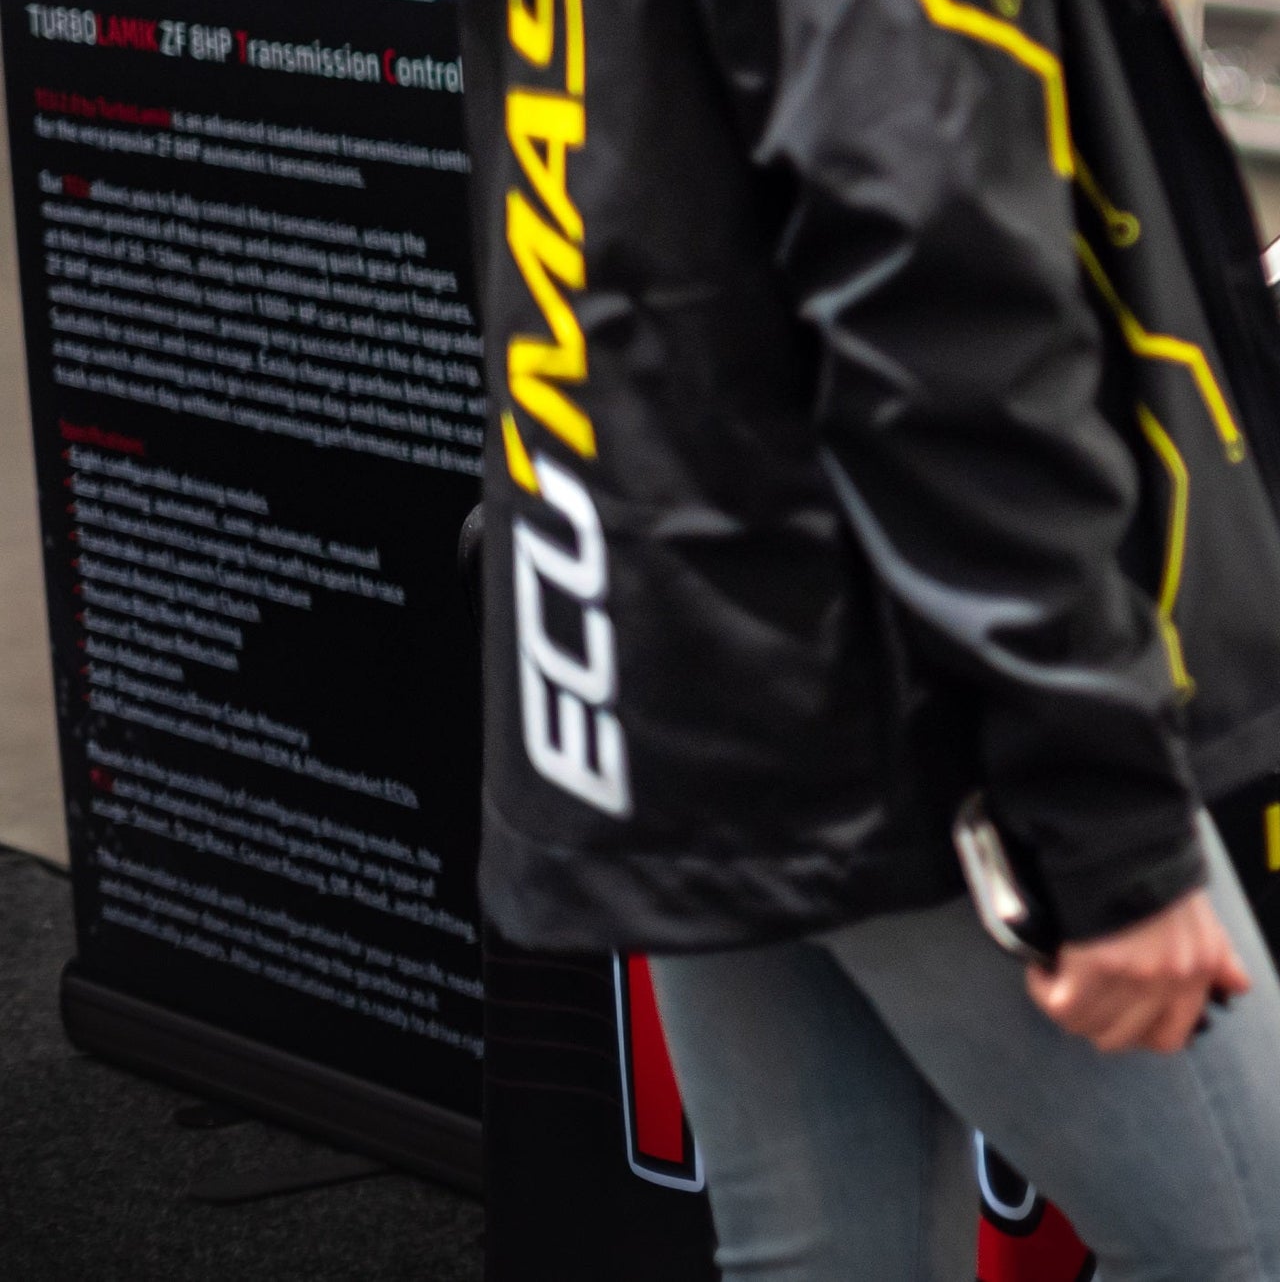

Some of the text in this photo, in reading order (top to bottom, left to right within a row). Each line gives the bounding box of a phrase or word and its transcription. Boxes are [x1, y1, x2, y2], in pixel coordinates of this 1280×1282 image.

[26, 2, 465, 95] TURBOLAMIK ZF 8HP Transmission Control
